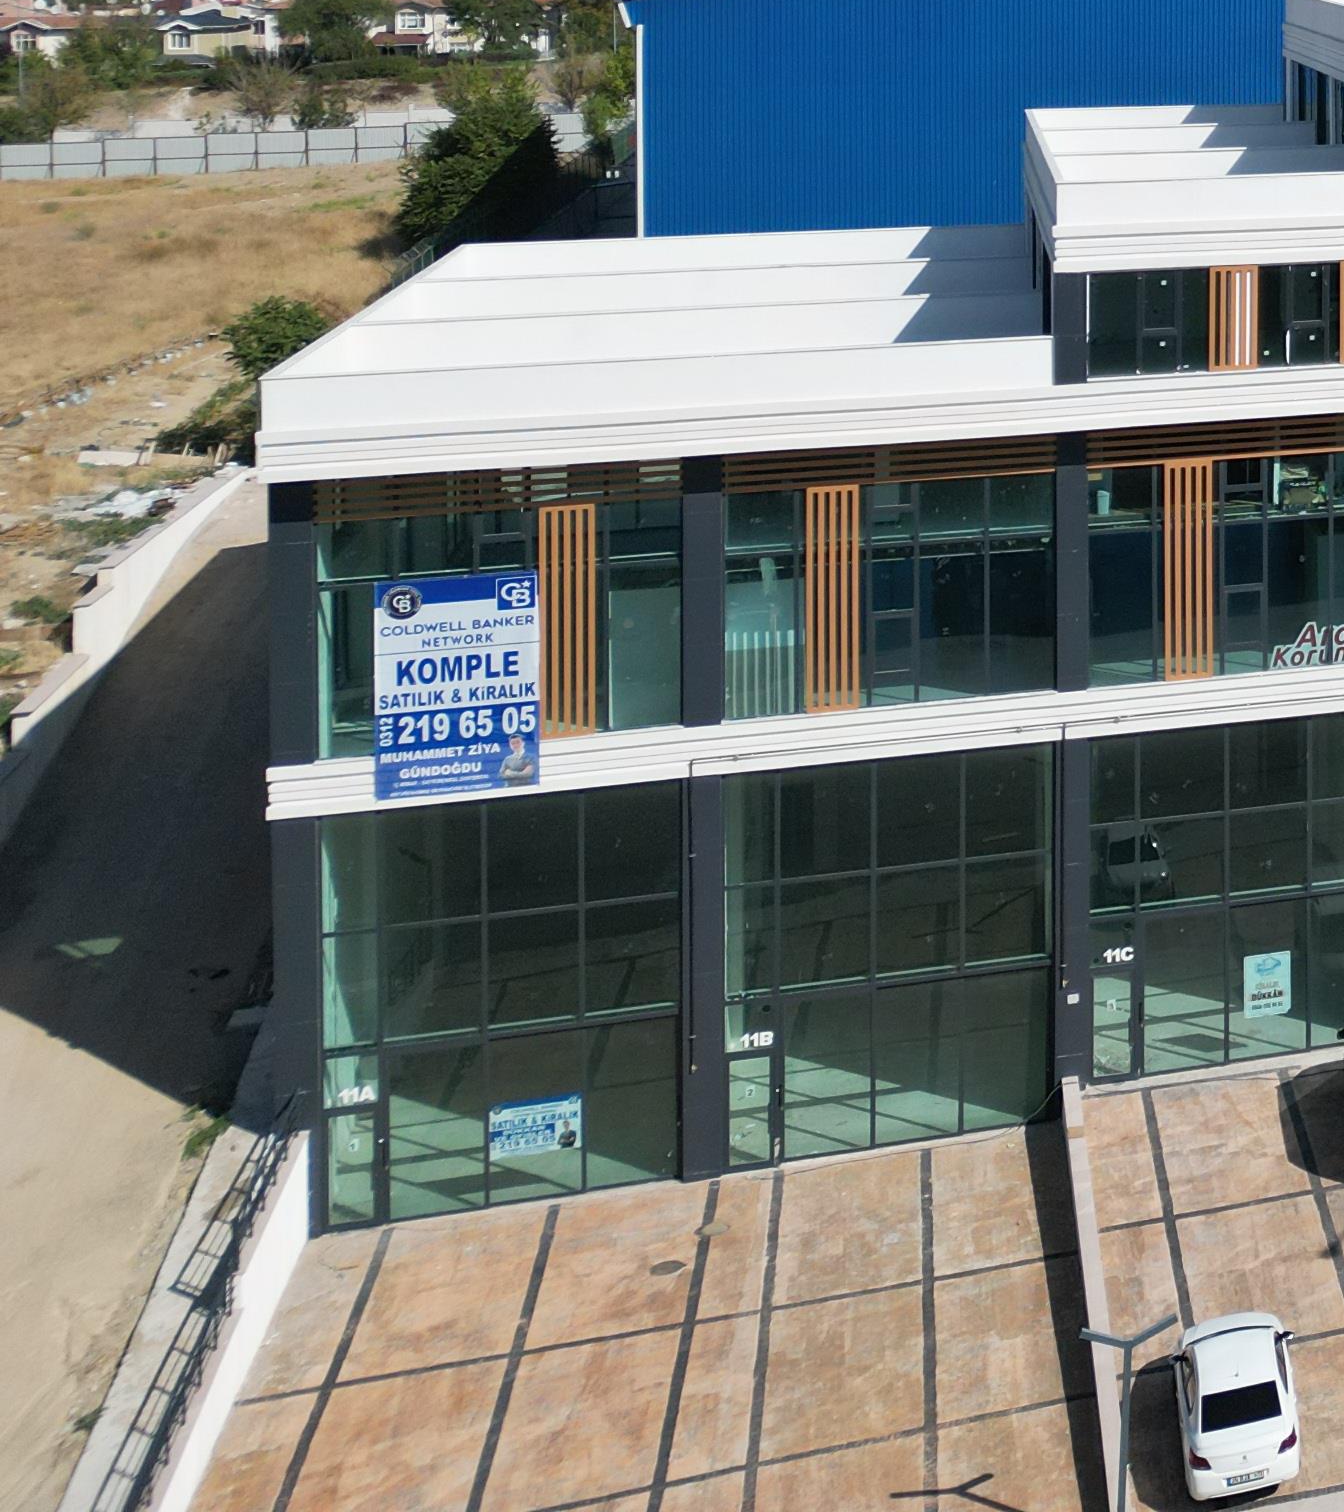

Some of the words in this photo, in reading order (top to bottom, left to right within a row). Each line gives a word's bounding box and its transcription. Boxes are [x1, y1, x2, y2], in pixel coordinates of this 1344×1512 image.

[380, 621, 466, 637] COLDWELL
[472, 614, 534, 630] BANKER
[421, 633, 494, 648] NETWORK
[396, 650, 520, 686] KOMPLE
[379, 690, 445, 710] SATILIK
[451, 688, 462, 703] &
[379, 716, 394, 748] 0312
[397, 713, 450, 745] 219
[459, 708, 494, 738] 65
[502, 705, 536, 734] 05
[380, 746, 465, 764] MUHAMMET
[468, 742, 501, 756] ZİYA
[400, 762, 482, 779] GÜNDOĞDU
[1102, 946, 1136, 964] 11C
[739, 1031, 775, 1048] 11B
[337, 1084, 376, 1104] 11A
